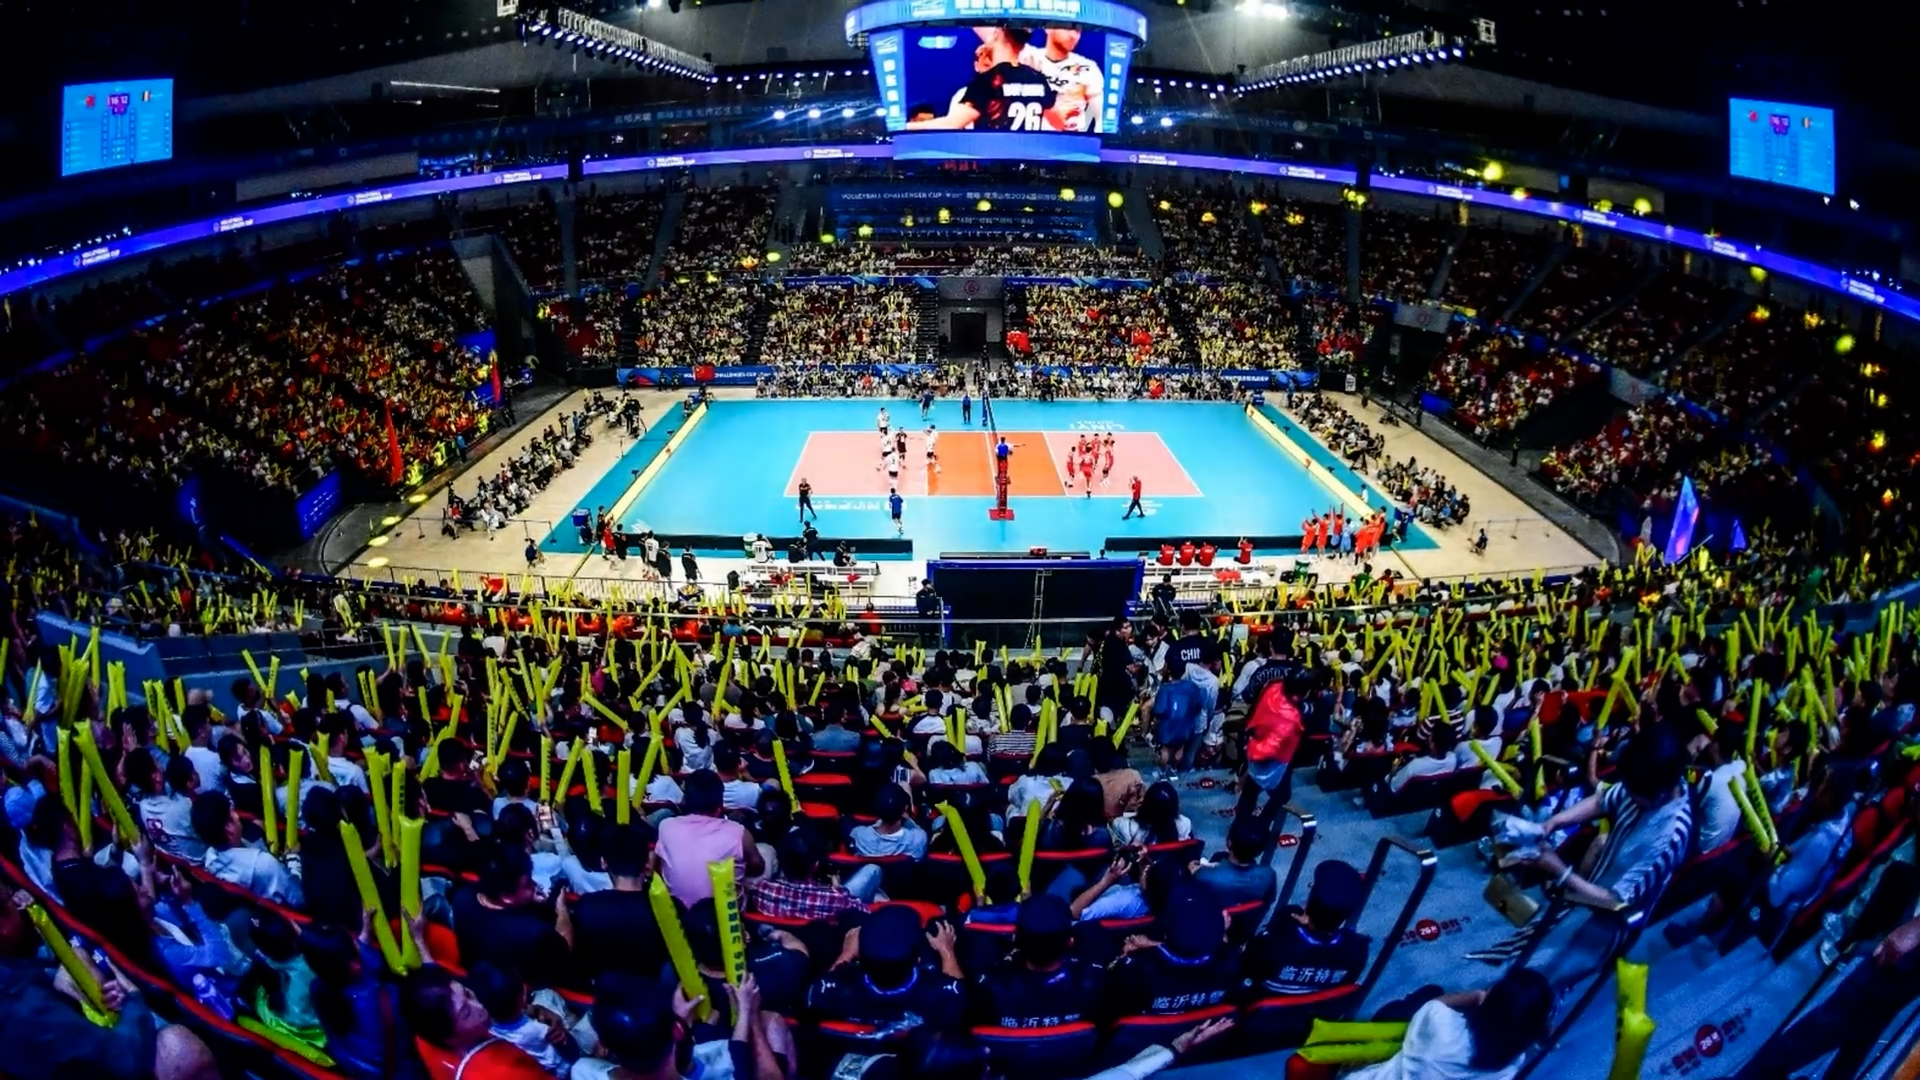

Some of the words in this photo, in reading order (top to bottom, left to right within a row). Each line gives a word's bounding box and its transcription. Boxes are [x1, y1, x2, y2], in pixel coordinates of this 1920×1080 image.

[1008, 102, 1042, 130] 26
[883, 191, 927, 199] CHALLENGER
[1278, 965, 1347, 983] 临沂特警
